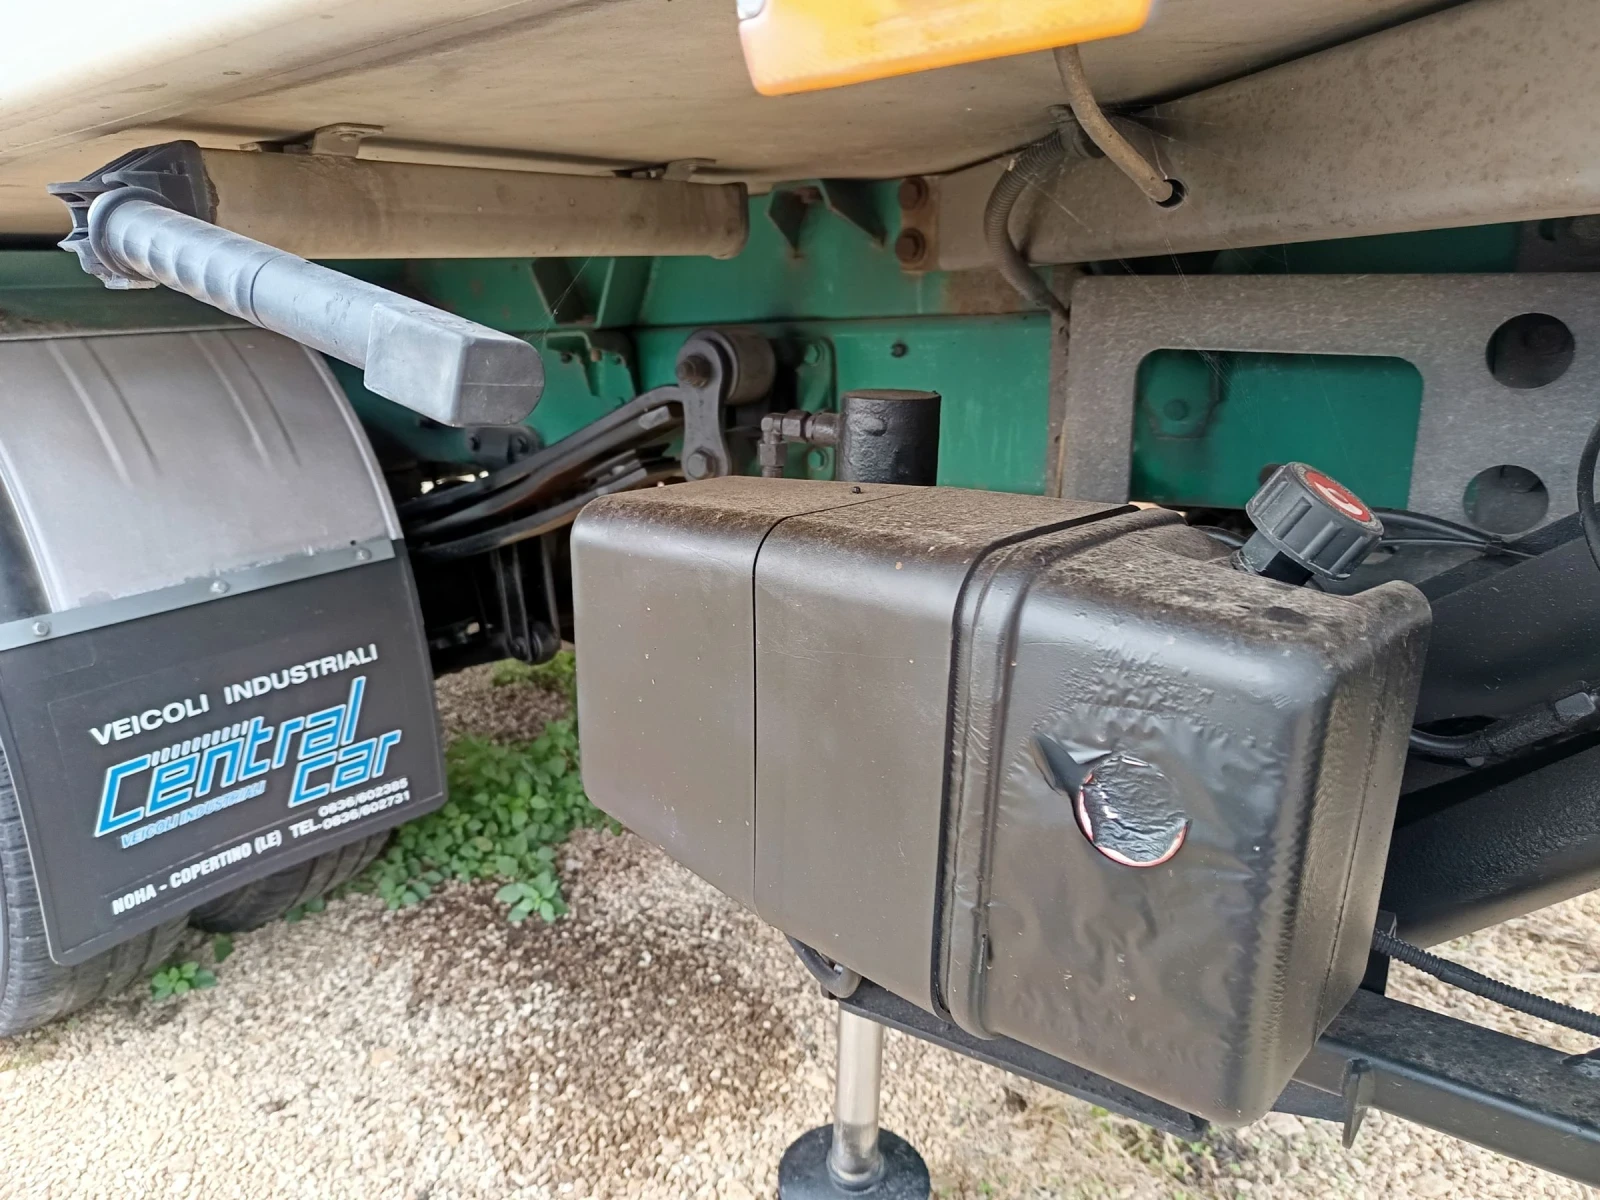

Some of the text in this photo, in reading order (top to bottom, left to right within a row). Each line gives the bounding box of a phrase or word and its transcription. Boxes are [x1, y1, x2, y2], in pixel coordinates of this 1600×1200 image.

[89, 643, 378, 746] VEICOLI INDUSTRIALI
[120, 780, 267, 849] VEICOLI INDUSTRIALI
[111, 883, 158, 915] NOHA
[169, 842, 252, 889] COPERTINO
[254, 829, 283, 855] (LE)
